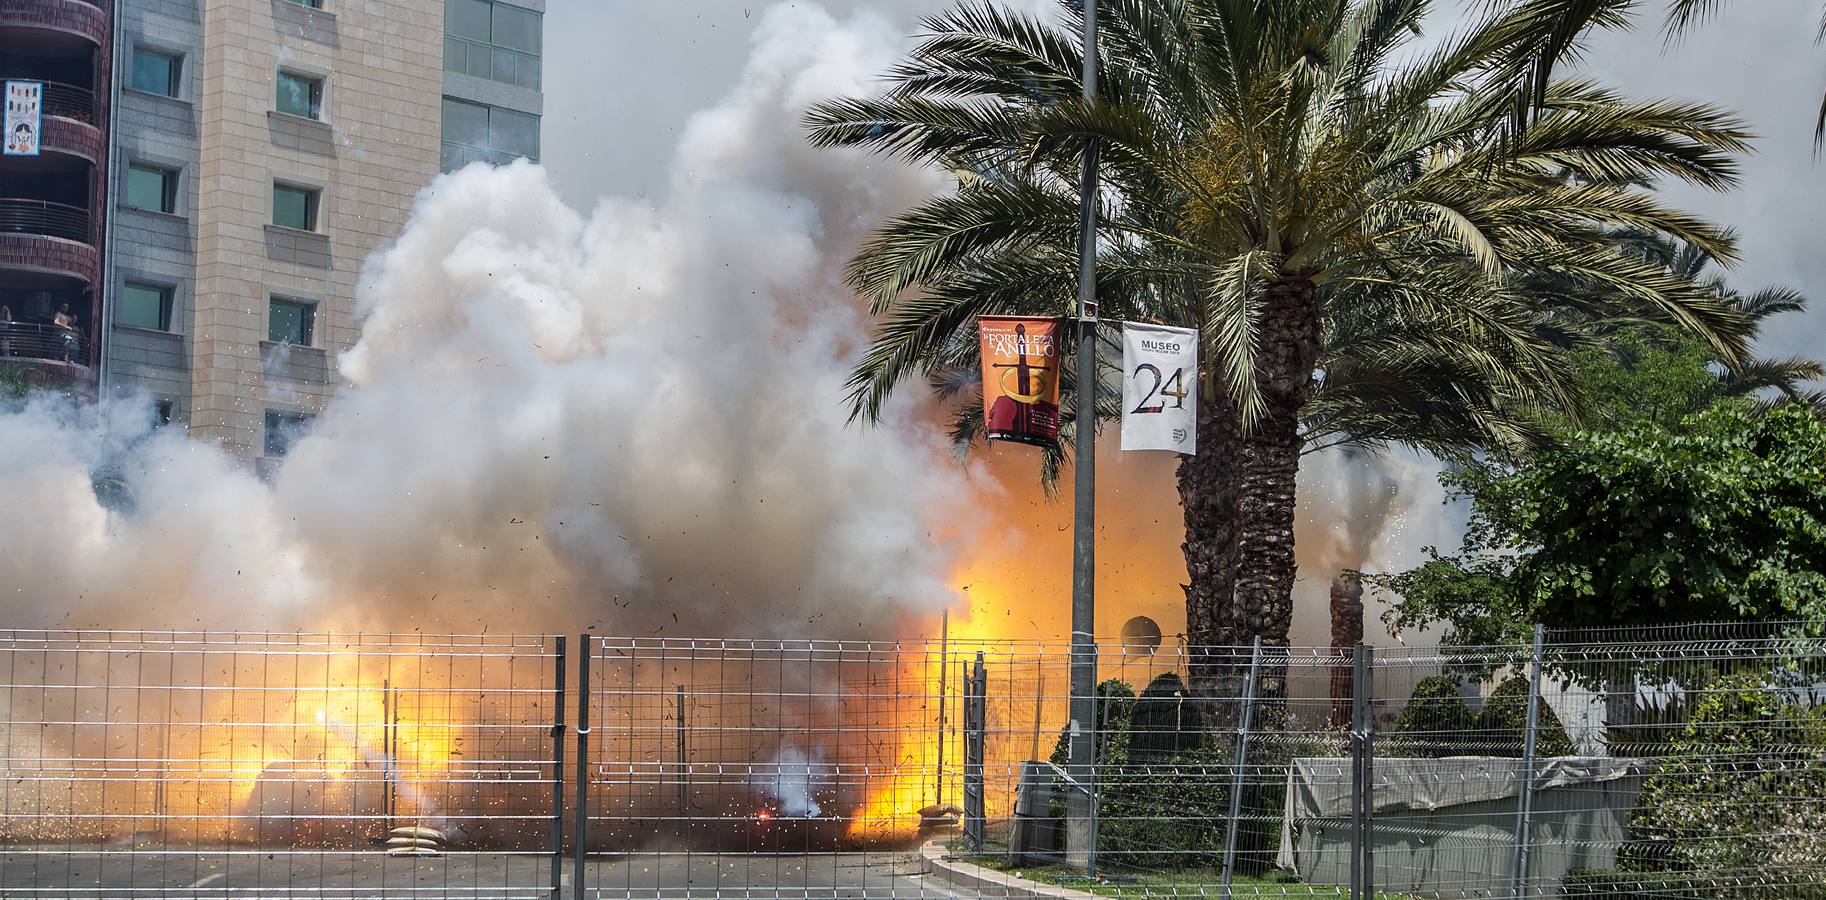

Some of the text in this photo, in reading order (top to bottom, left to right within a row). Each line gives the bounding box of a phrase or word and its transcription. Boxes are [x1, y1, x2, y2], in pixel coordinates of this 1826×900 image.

[989, 333, 1055, 345] FORTALEZA
[1141, 340, 1181, 351] MUSEO
[994, 342, 1055, 358] ANILLO
[1131, 363, 1189, 414] 24
